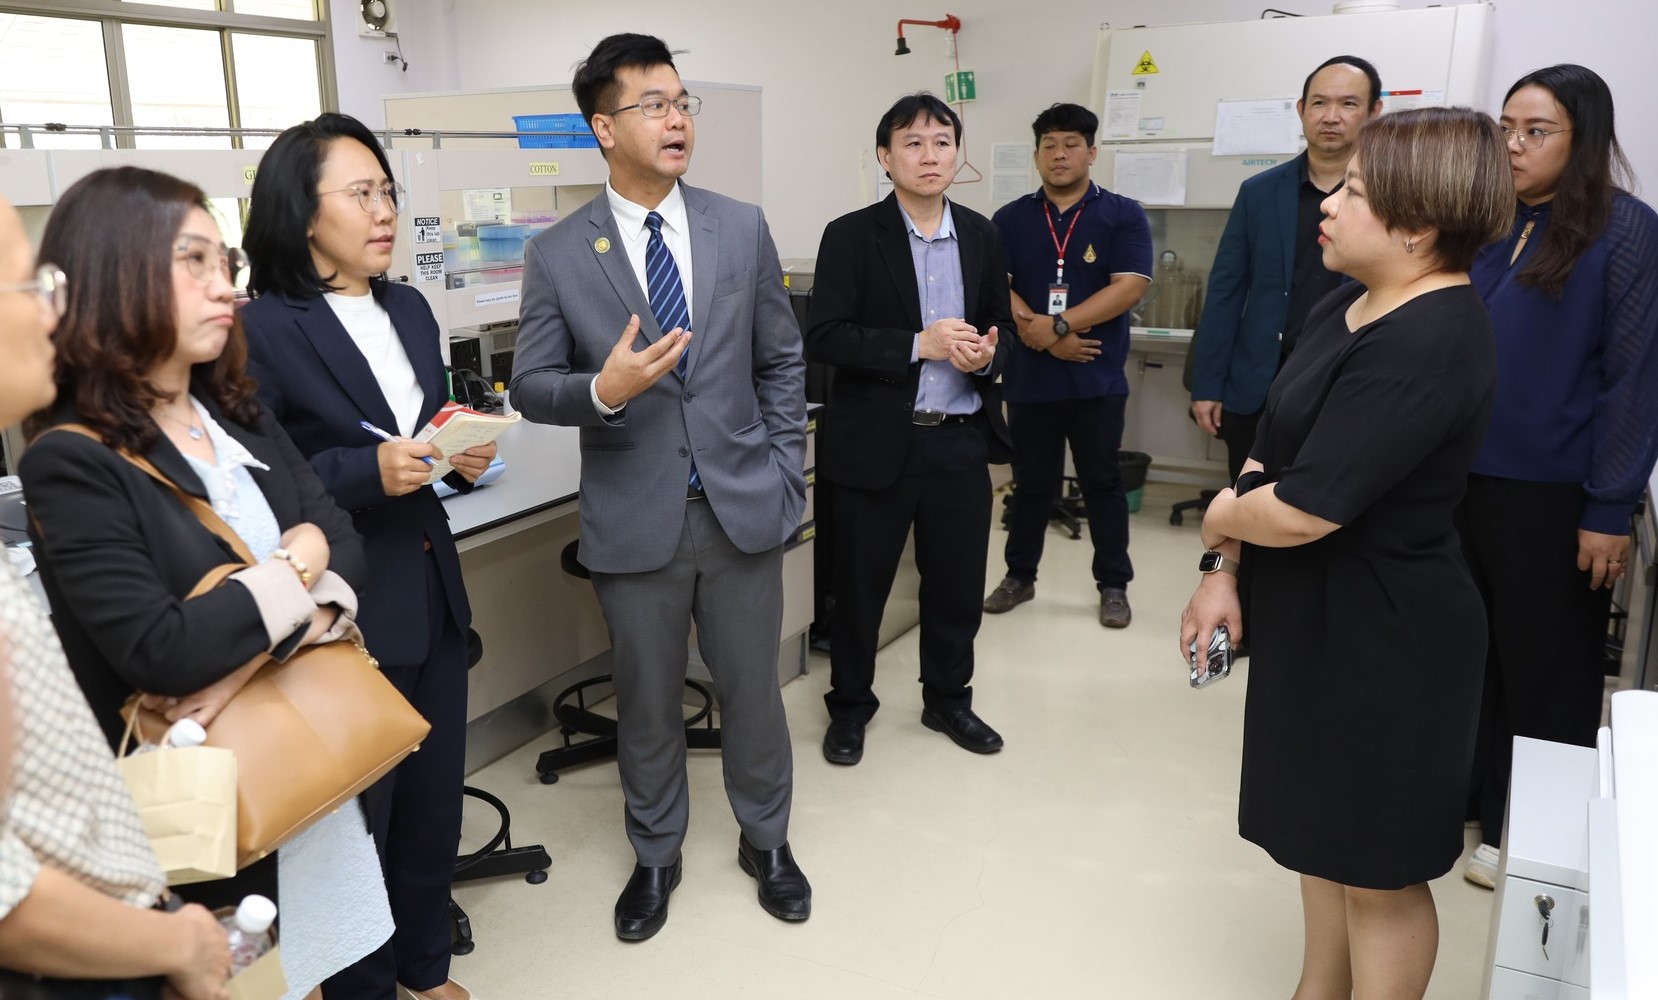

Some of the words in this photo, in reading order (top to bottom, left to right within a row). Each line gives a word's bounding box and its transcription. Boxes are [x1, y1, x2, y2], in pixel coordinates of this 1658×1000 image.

[530, 164, 557, 173] COTTON
[416, 218, 438, 226] NOTICE
[417, 254, 443, 264] PLEASE
